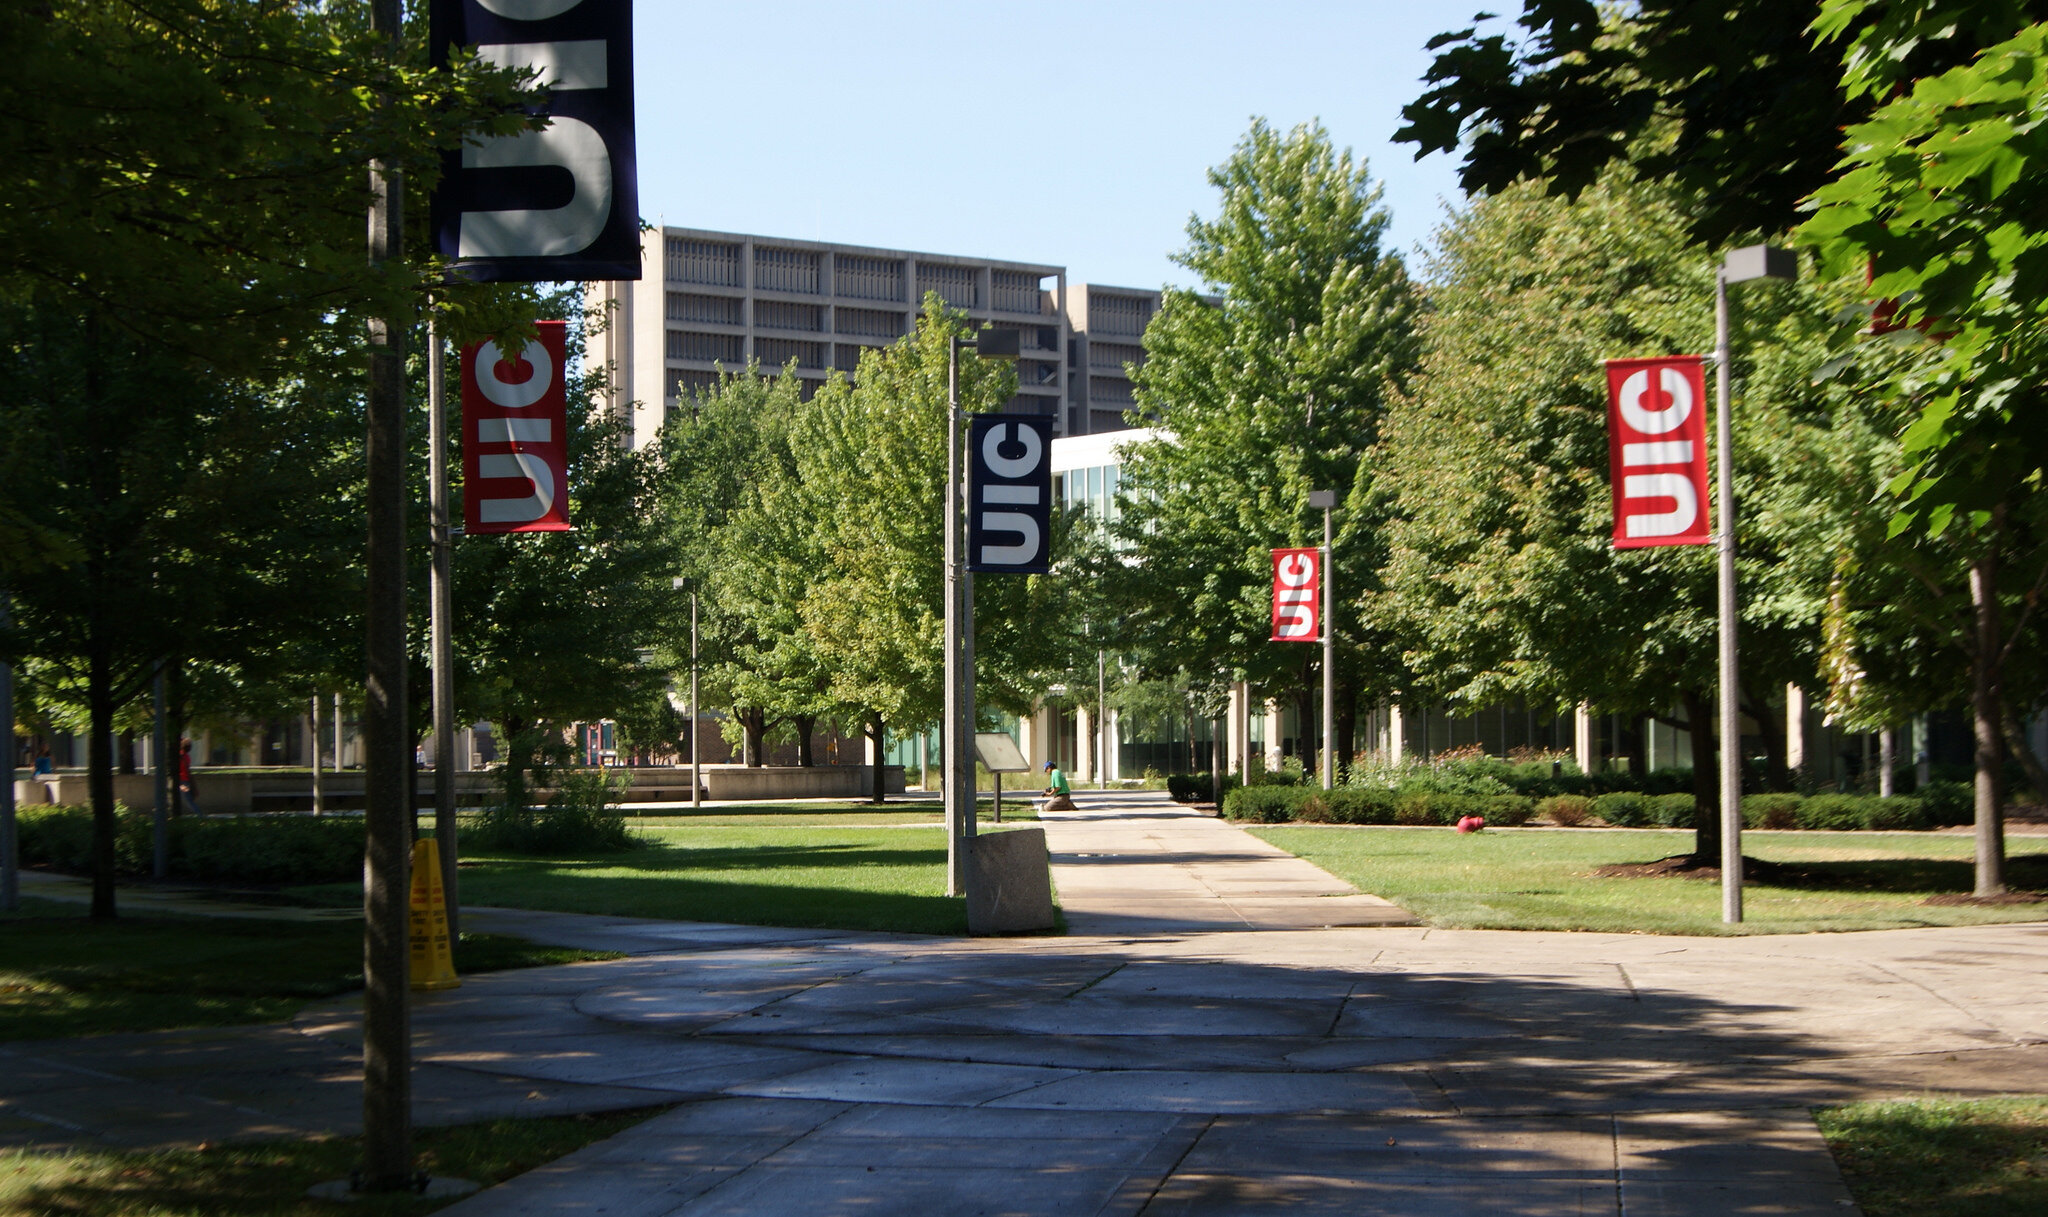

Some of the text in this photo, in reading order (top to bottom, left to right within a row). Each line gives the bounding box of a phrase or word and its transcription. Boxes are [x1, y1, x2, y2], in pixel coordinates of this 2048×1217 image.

[459, 0, 612, 258] UI
[475, 336, 554, 523] UIC
[981, 423, 1042, 565] UIC
[1619, 367, 1698, 538] UIC
[1278, 554, 1313, 636] UIC
